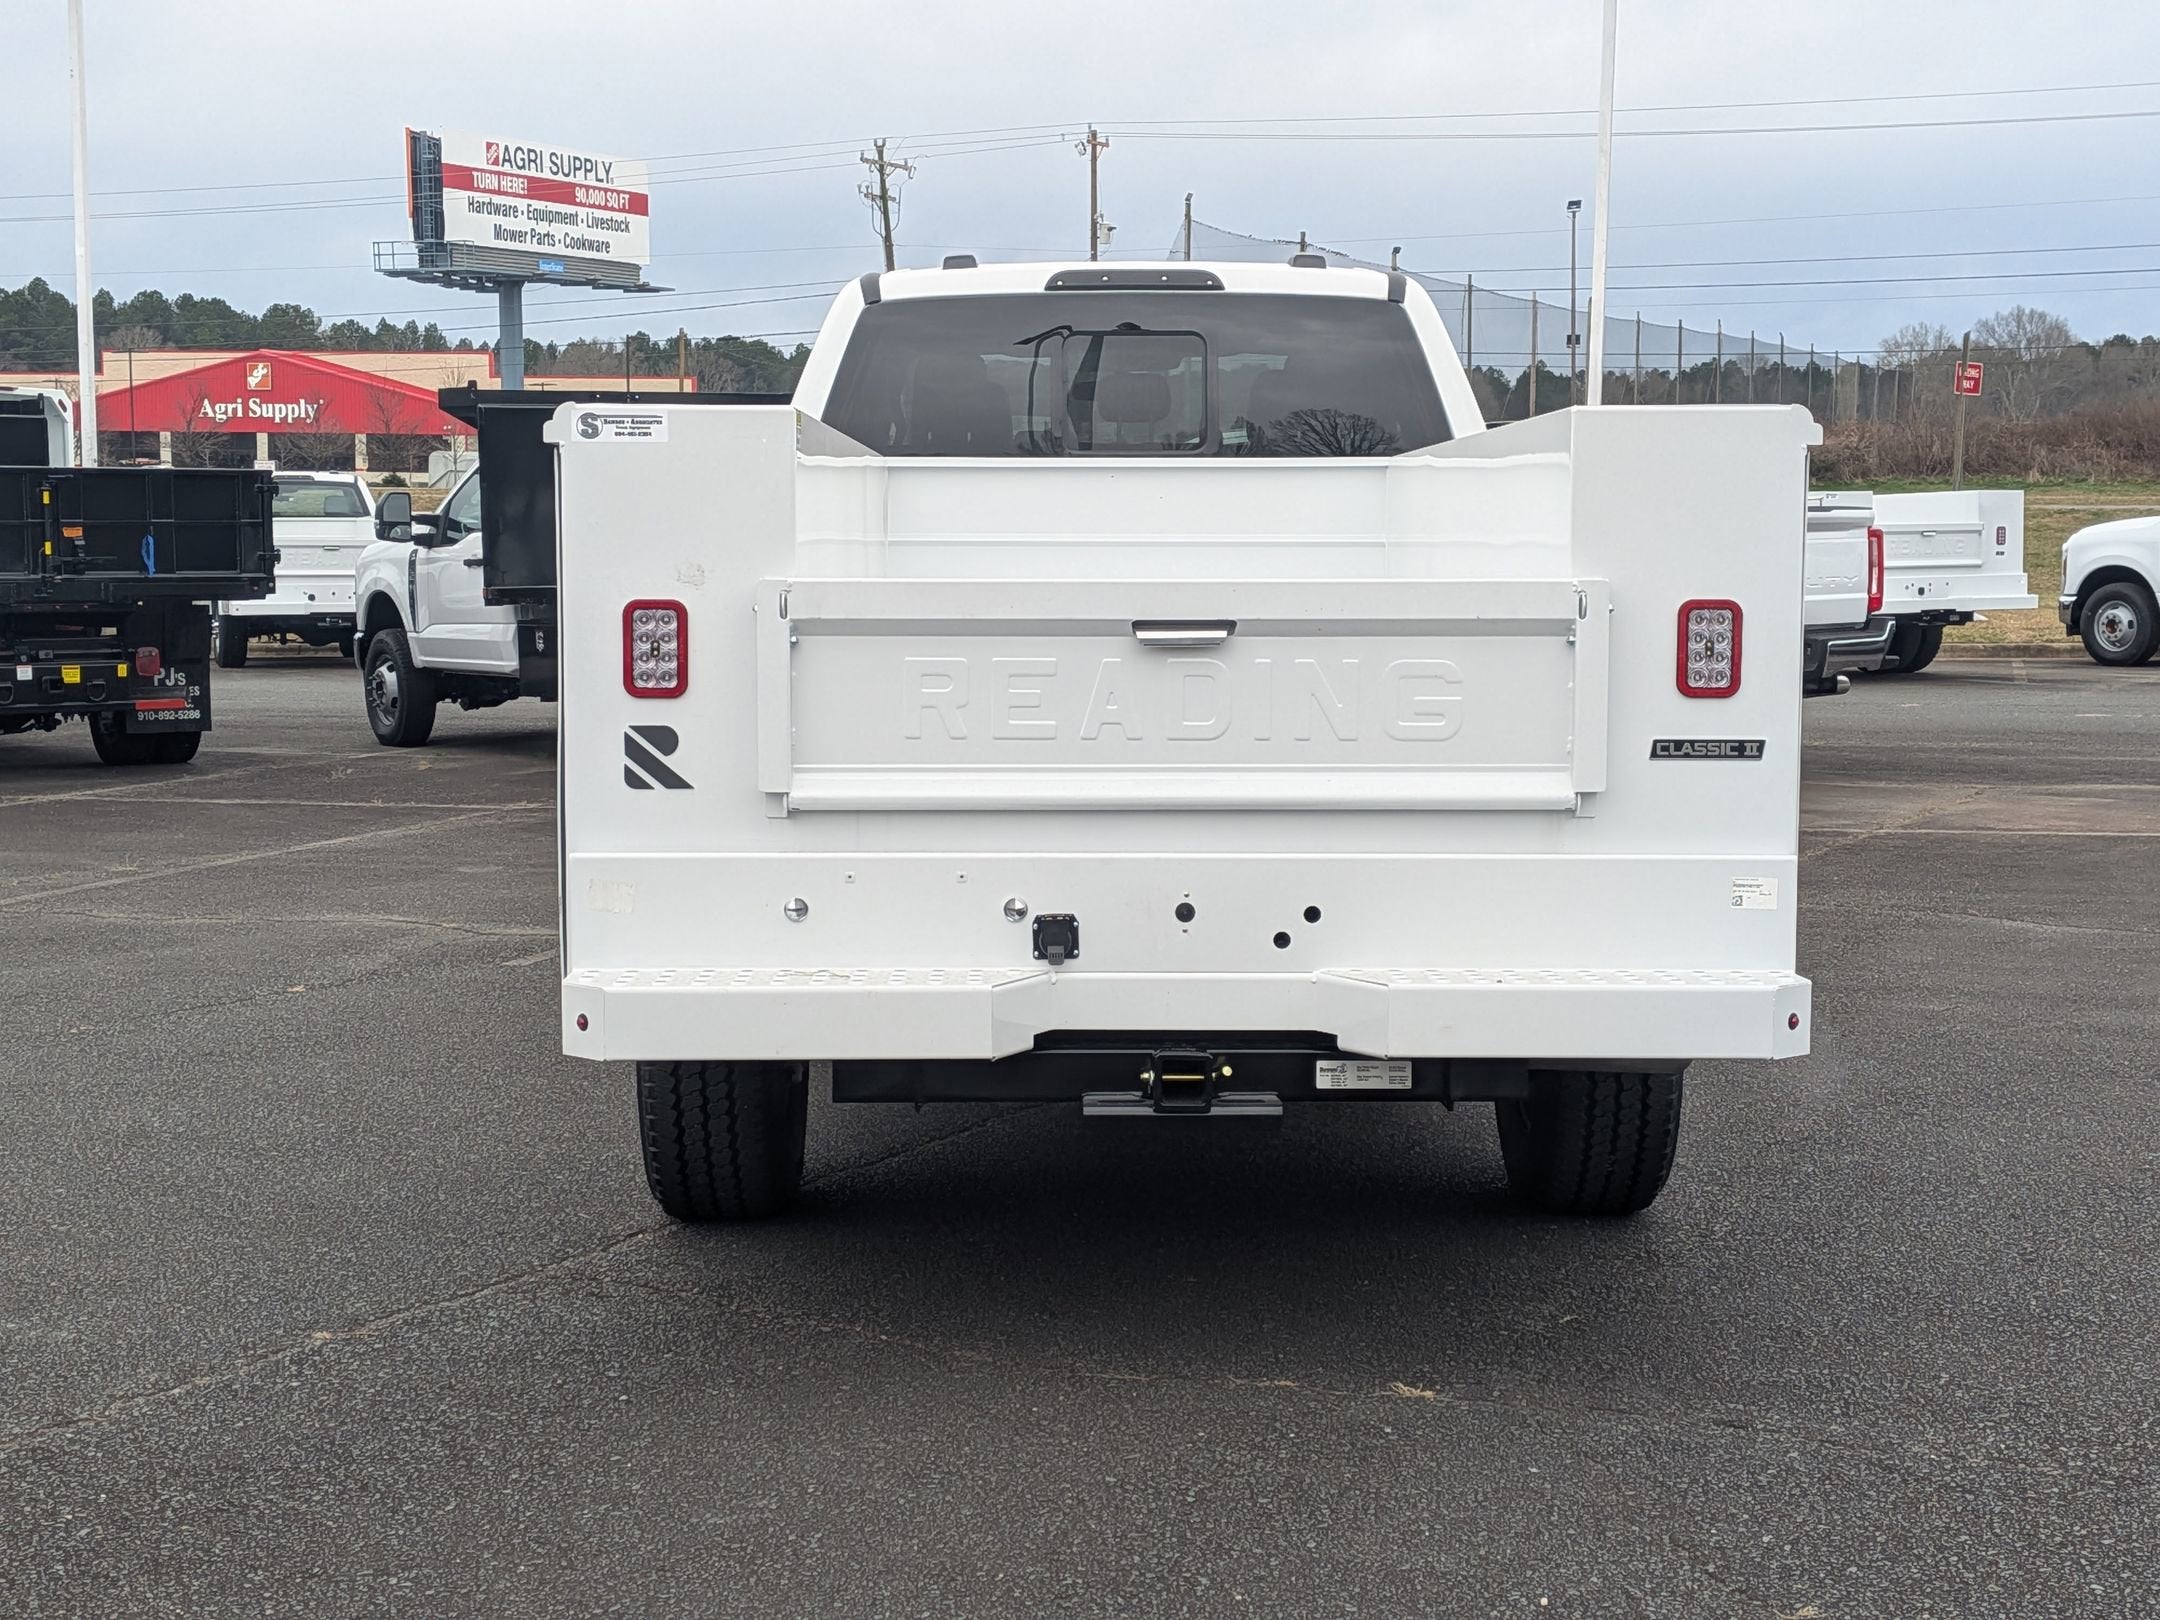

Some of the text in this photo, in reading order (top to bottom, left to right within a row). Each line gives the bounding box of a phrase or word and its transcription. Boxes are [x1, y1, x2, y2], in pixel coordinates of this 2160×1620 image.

[501, 143, 613, 185] AGRI SUPPLY
[471, 171, 528, 195] TURN HERE!
[575, 186, 630, 209] 90,000 SQ FT
[467, 195, 631, 233] Hardware Equipment Livestock
[493, 223, 611, 254] Mower Parts Cookware
[199, 398, 317, 424] Agri Supply
[904, 657, 1464, 742] READING
[1656, 742, 1760, 756] CLASSIC II
